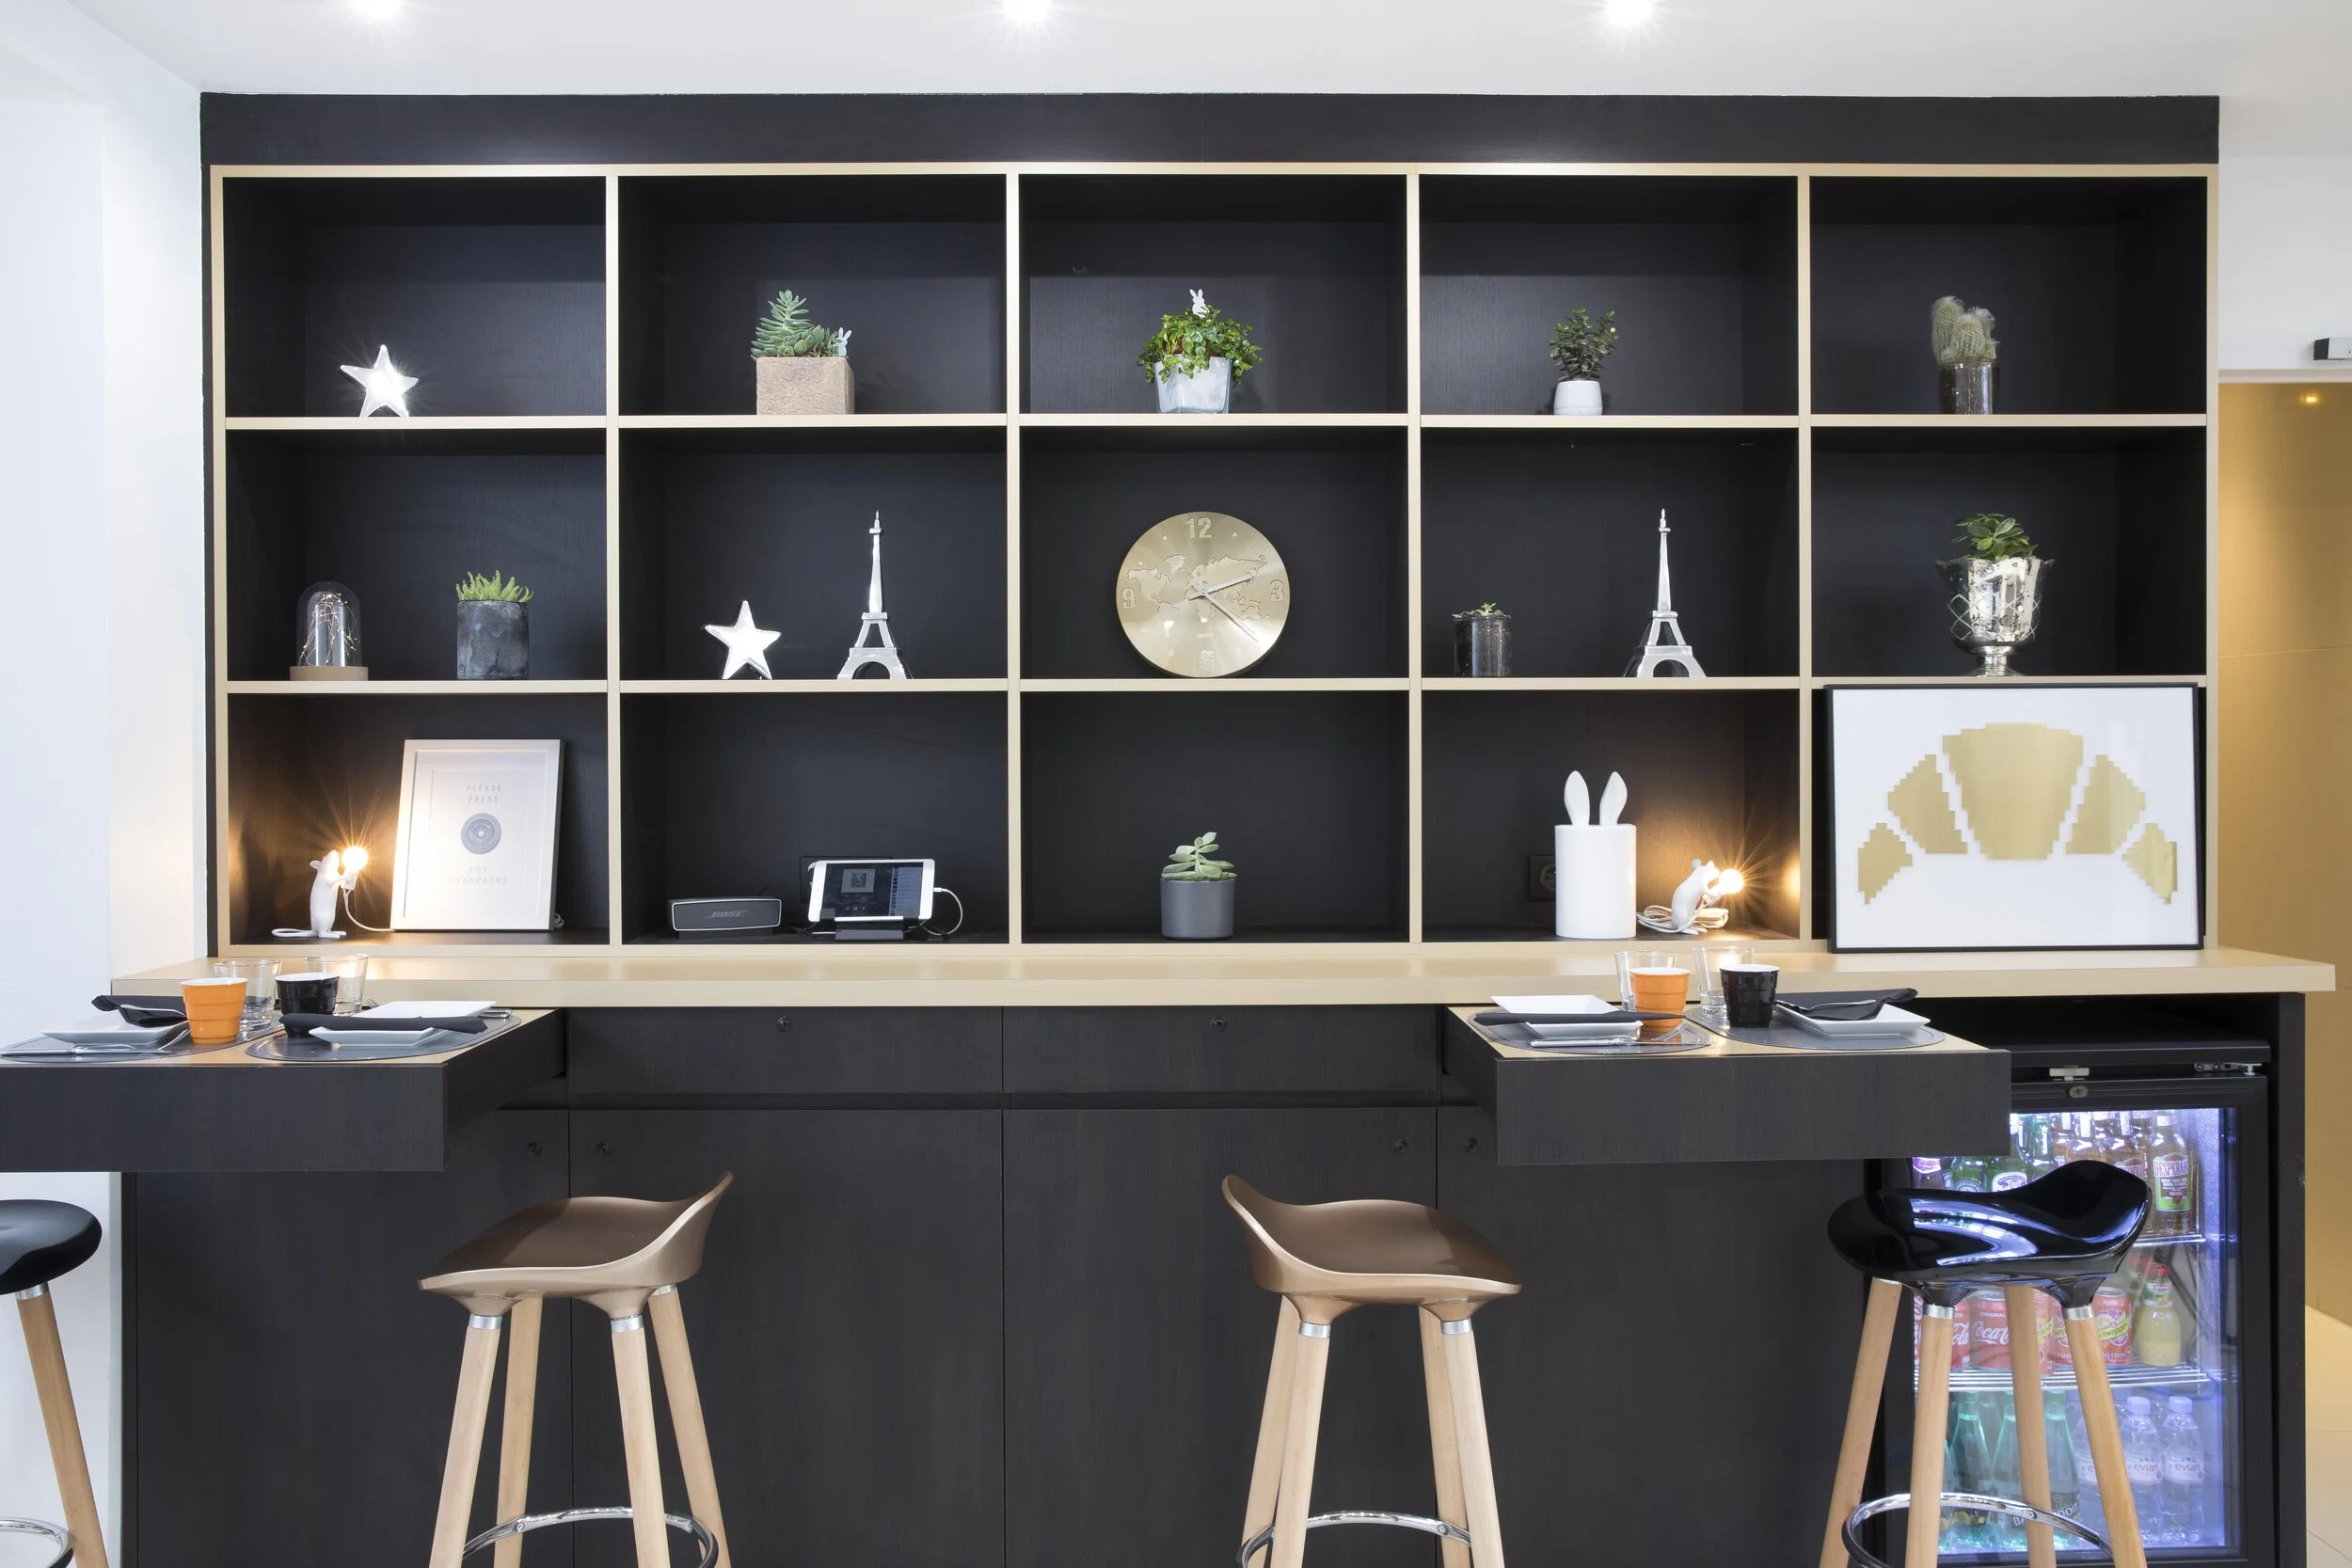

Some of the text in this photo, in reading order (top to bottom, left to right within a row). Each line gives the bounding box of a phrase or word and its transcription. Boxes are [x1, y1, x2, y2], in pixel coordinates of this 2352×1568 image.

[1185, 517, 1213, 540] 12
[1121, 587, 1136, 610] 9
[1270, 579, 1285, 602] 3
[709, 910, 746, 918] BOSE
[2134, 1463, 2159, 1472] evian
[2175, 1463, 2201, 1472] evian
